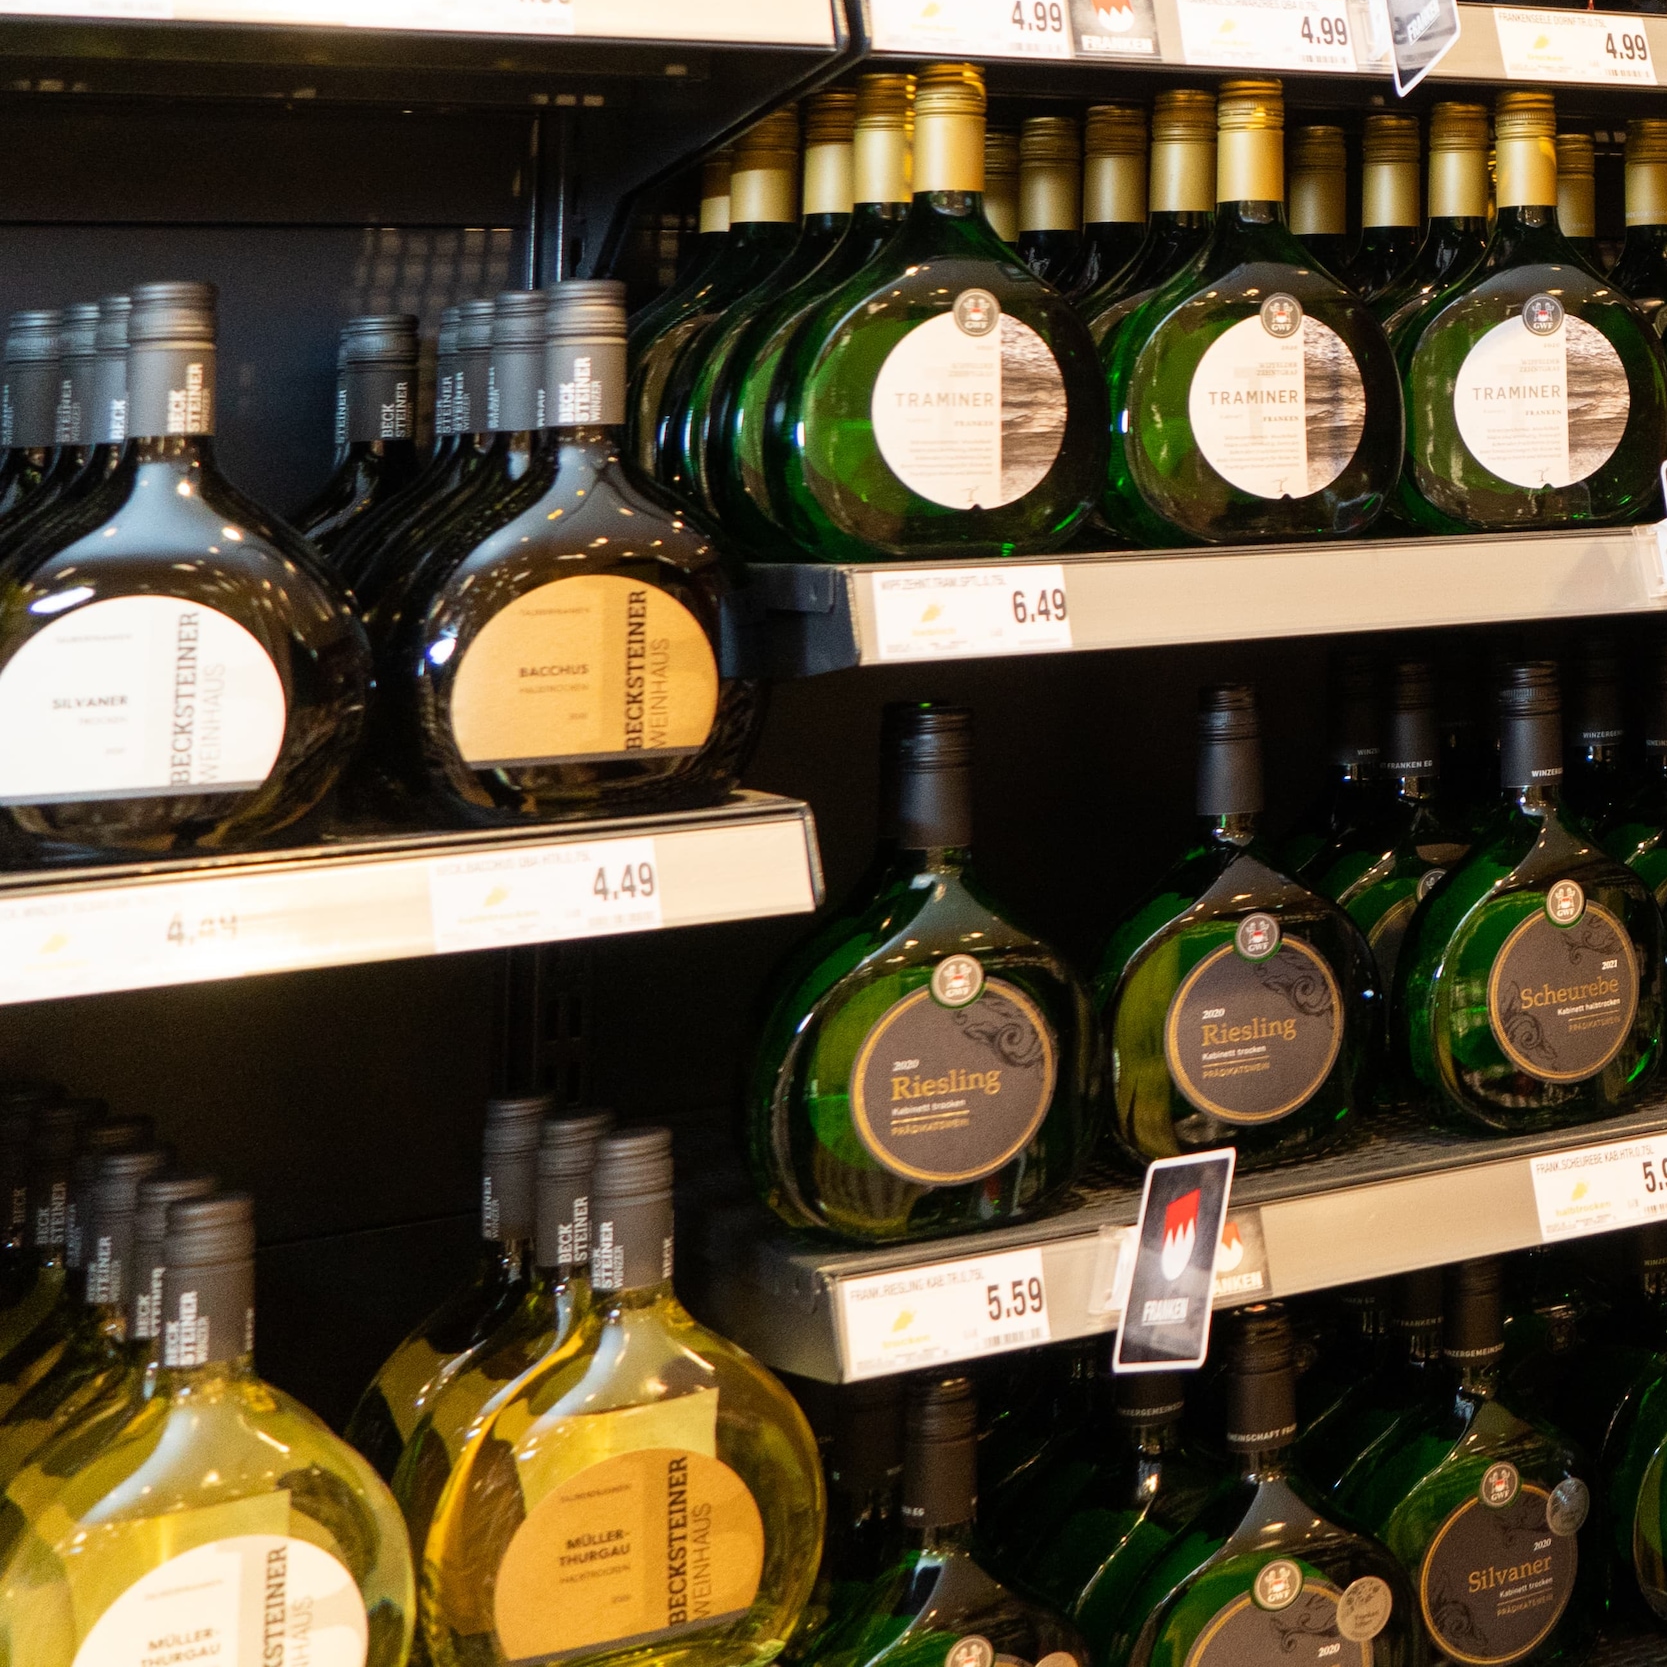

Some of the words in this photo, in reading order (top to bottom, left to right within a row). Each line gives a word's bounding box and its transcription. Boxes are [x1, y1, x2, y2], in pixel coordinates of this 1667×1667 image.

[1012, 1, 1063, 32] 4.99
[1301, 17, 1348, 45] 4.99
[1083, 36, 1153, 54] FRANKEN
[1605, 33, 1647, 61] 4.99
[558, 383, 574, 423] BECK
[574, 357, 591, 424] STEINER
[896, 393, 994, 408] TRAMINER
[1209, 390, 1298, 405] TRAMINER
[1473, 384, 1561, 401] TRAMINER
[1013, 589, 1066, 622] 6.49
[519, 664, 589, 679] BACCHUS
[626, 590, 647, 750] BECKSTEINER
[52, 694, 129, 710] SILVANER
[170, 612, 199, 786] BECKSTEINER
[649, 638, 670, 750] WEINHAUS
[592, 863, 655, 900] 4.49
[1520, 976, 1620, 1010] Scheurebe
[1201, 1017, 1297, 1047] Riesling
[891, 1070, 1001, 1102] Riesling
[987, 1277, 1044, 1323] 5.59
[1142, 1297, 1189, 1325] FRANKEN
[558, 1543, 630, 1567] THURGAU
[566, 1528, 625, 1551] MÜLLER-
[667, 1456, 687, 1626] BECKSTEINER
[1533, 1538, 1552, 1551] 2020
[691, 1502, 712, 1623] WEINHAUS
[1467, 1555, 1552, 1594] Silvaner
